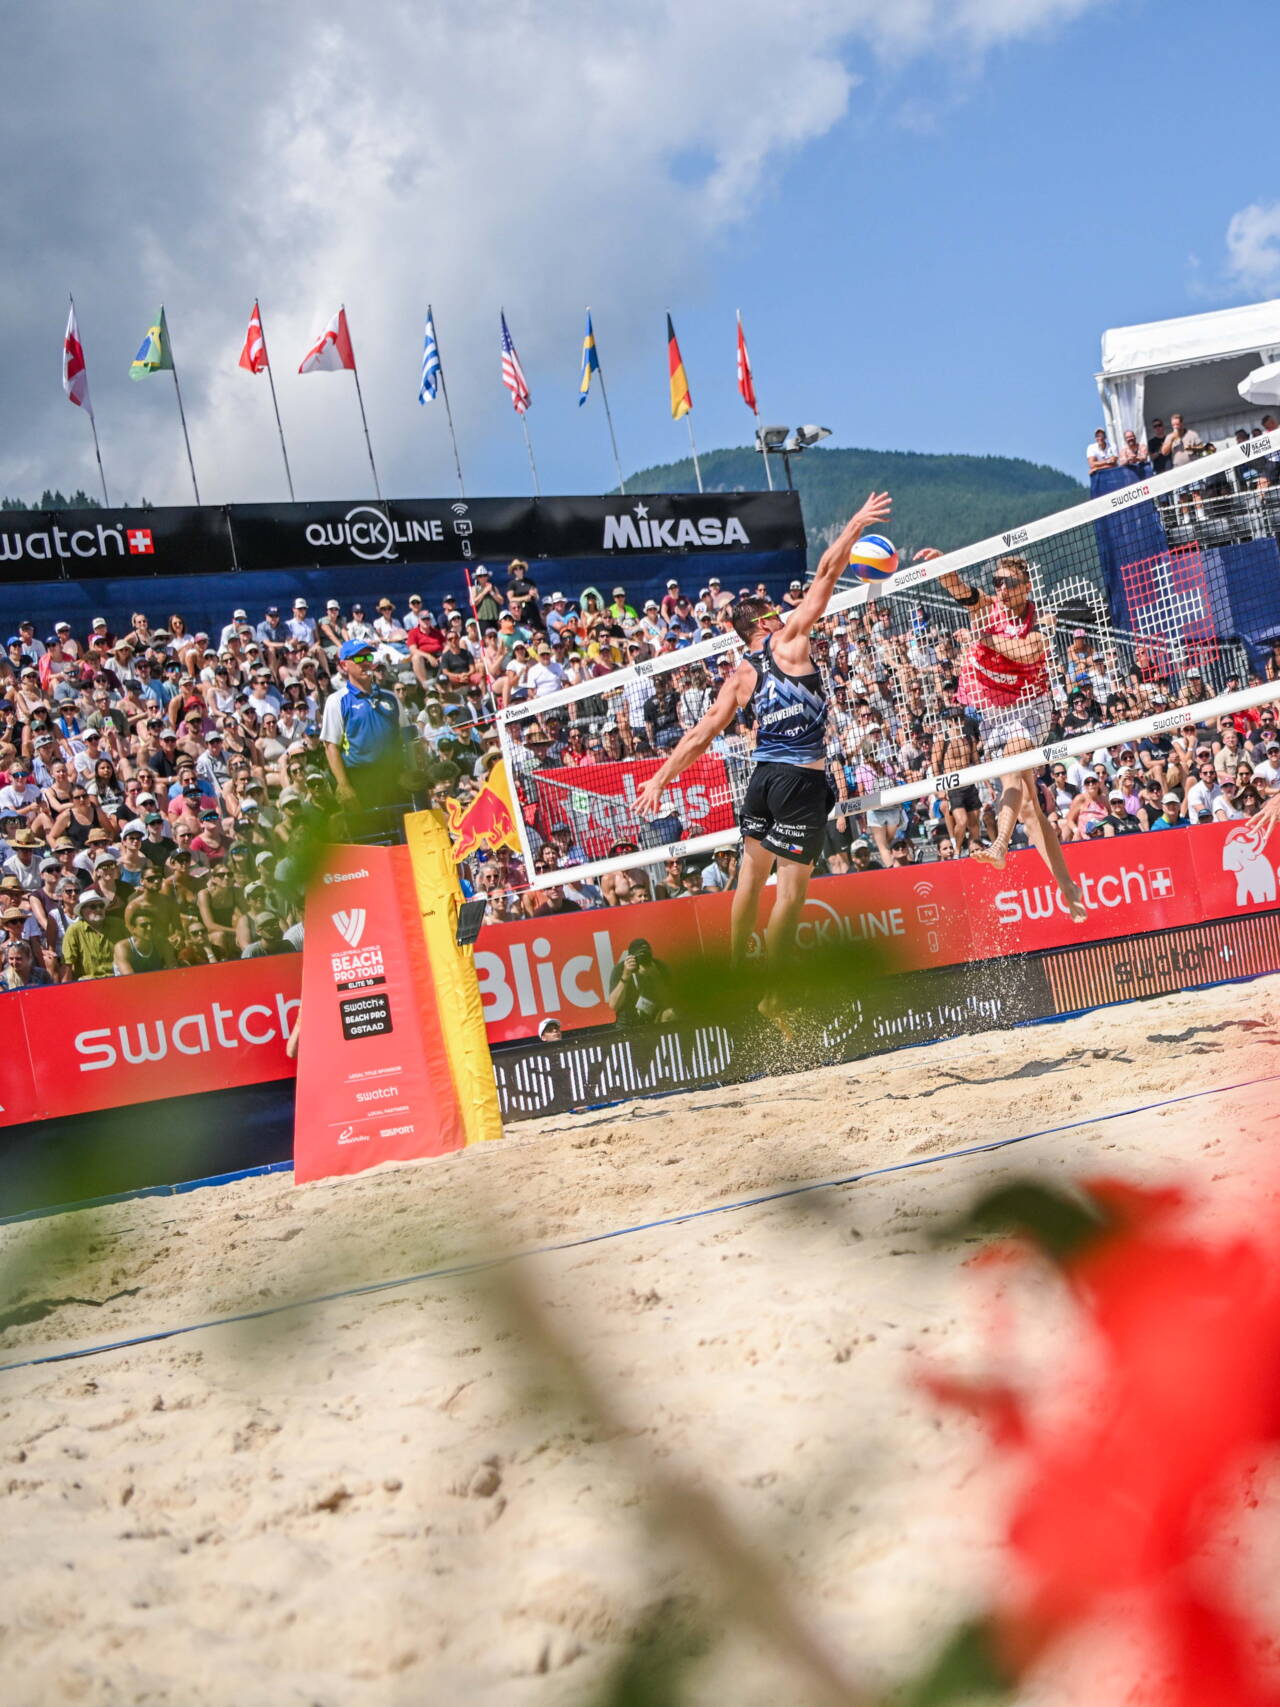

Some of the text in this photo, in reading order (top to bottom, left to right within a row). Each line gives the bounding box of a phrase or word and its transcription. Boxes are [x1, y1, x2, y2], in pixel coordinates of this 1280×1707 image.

[1111, 487, 1143, 507] swatch
[603, 514, 750, 549] MIKASA
[0, 523, 125, 560] watch
[766, 680, 777, 700] 2
[511, 706, 529, 718] Senoh
[762, 703, 804, 725] SCHWEINER
[1153, 714, 1185, 731] swatch
[334, 869, 369, 883] Senoh
[331, 951, 383, 972] BEACH
[333, 965, 384, 982] PRO TOUR
[348, 980, 366, 989] ELITE
[345, 1010, 386, 1024] BEACH PRO
[350, 1022, 384, 1035] GSTAAD
[356, 1086, 398, 1102] swatch
